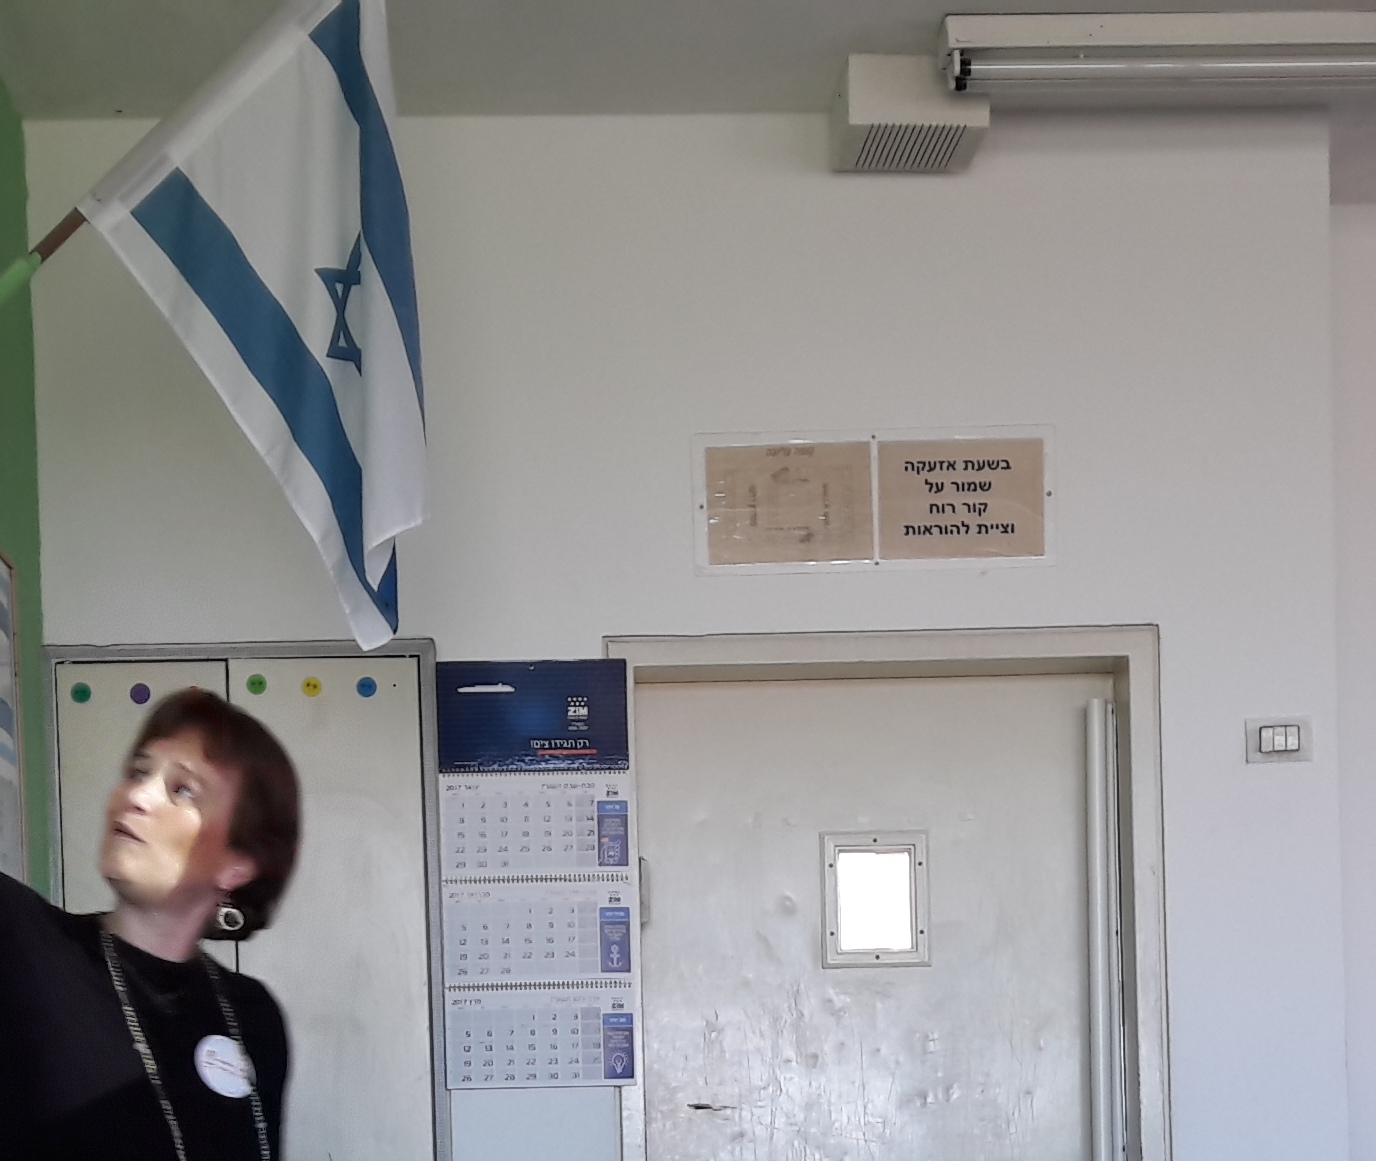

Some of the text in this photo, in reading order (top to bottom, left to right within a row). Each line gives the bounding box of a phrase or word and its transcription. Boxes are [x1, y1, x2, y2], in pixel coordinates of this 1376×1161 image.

[903, 457, 1012, 474] בשעת אזעקה
[924, 478, 992, 493] שמור על
[928, 501, 988, 517] קור רוח
[903, 521, 1016, 537] וציית להוראות
